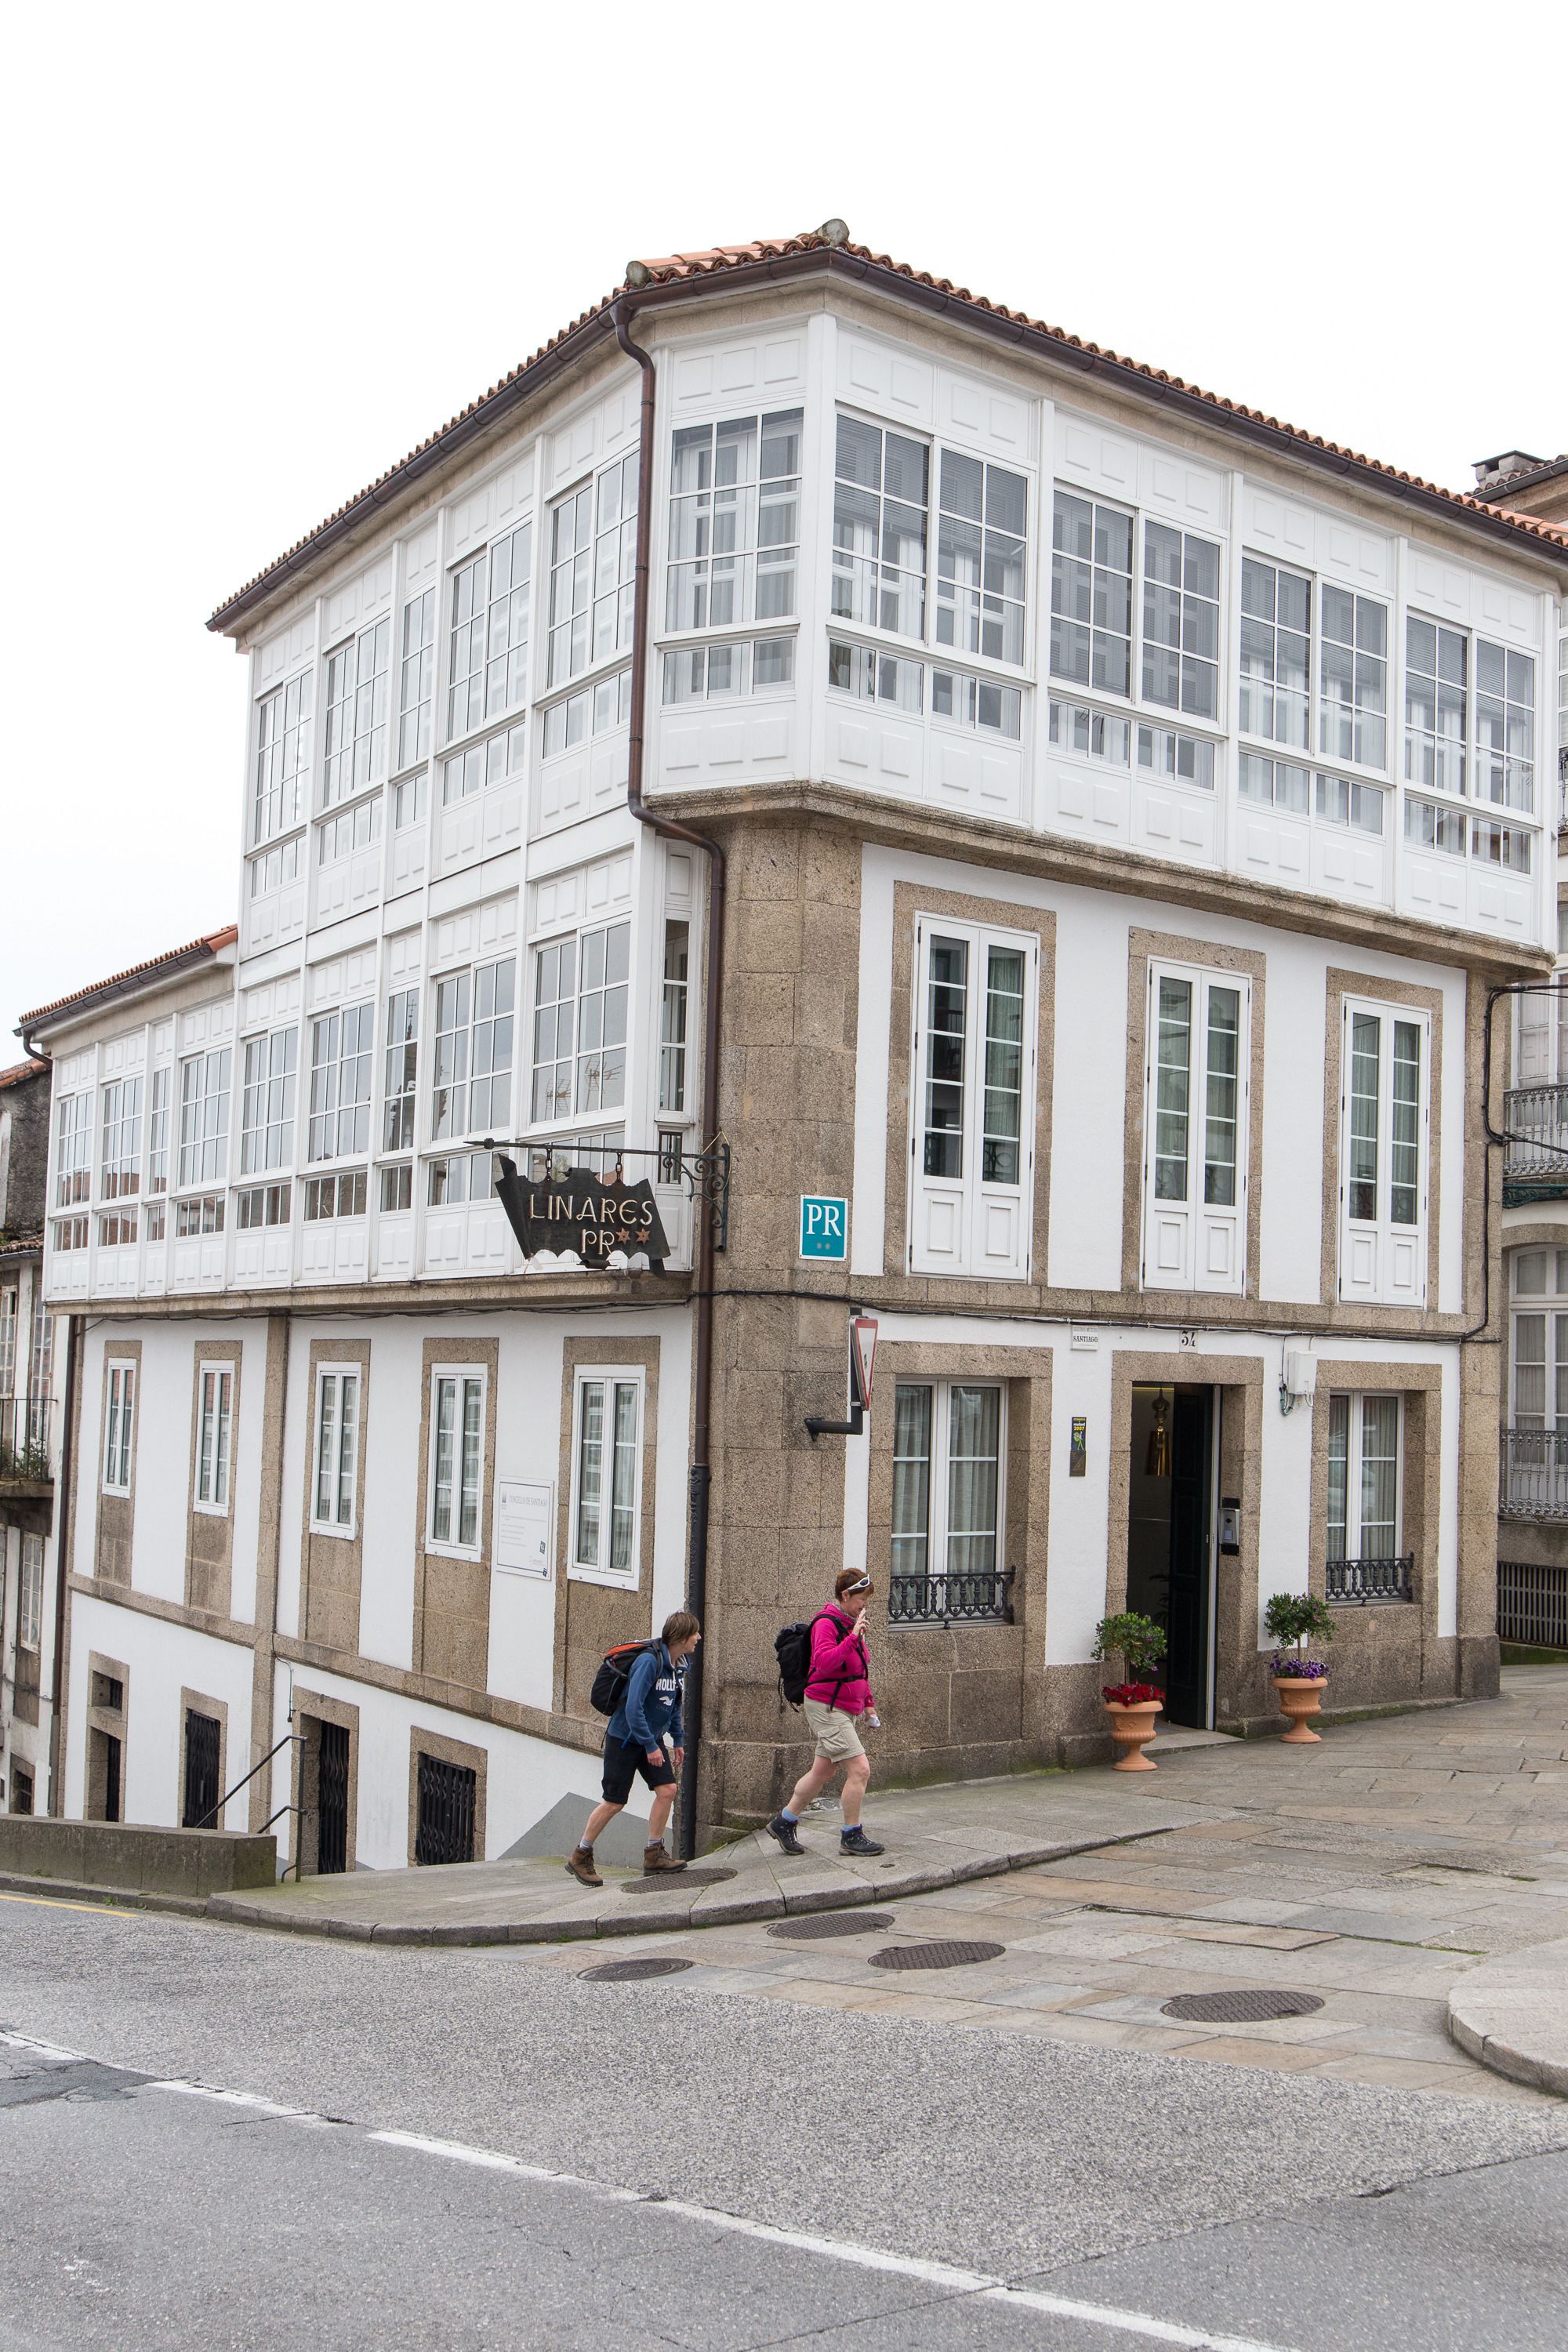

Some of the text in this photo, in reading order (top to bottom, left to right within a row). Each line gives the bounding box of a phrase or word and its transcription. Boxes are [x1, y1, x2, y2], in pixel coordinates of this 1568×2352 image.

[529, 1194, 653, 1225] LINARES
[806, 1204, 842, 1236] PR
[581, 1229, 615, 1255] PR
[1181, 1330, 1196, 1347] 34
